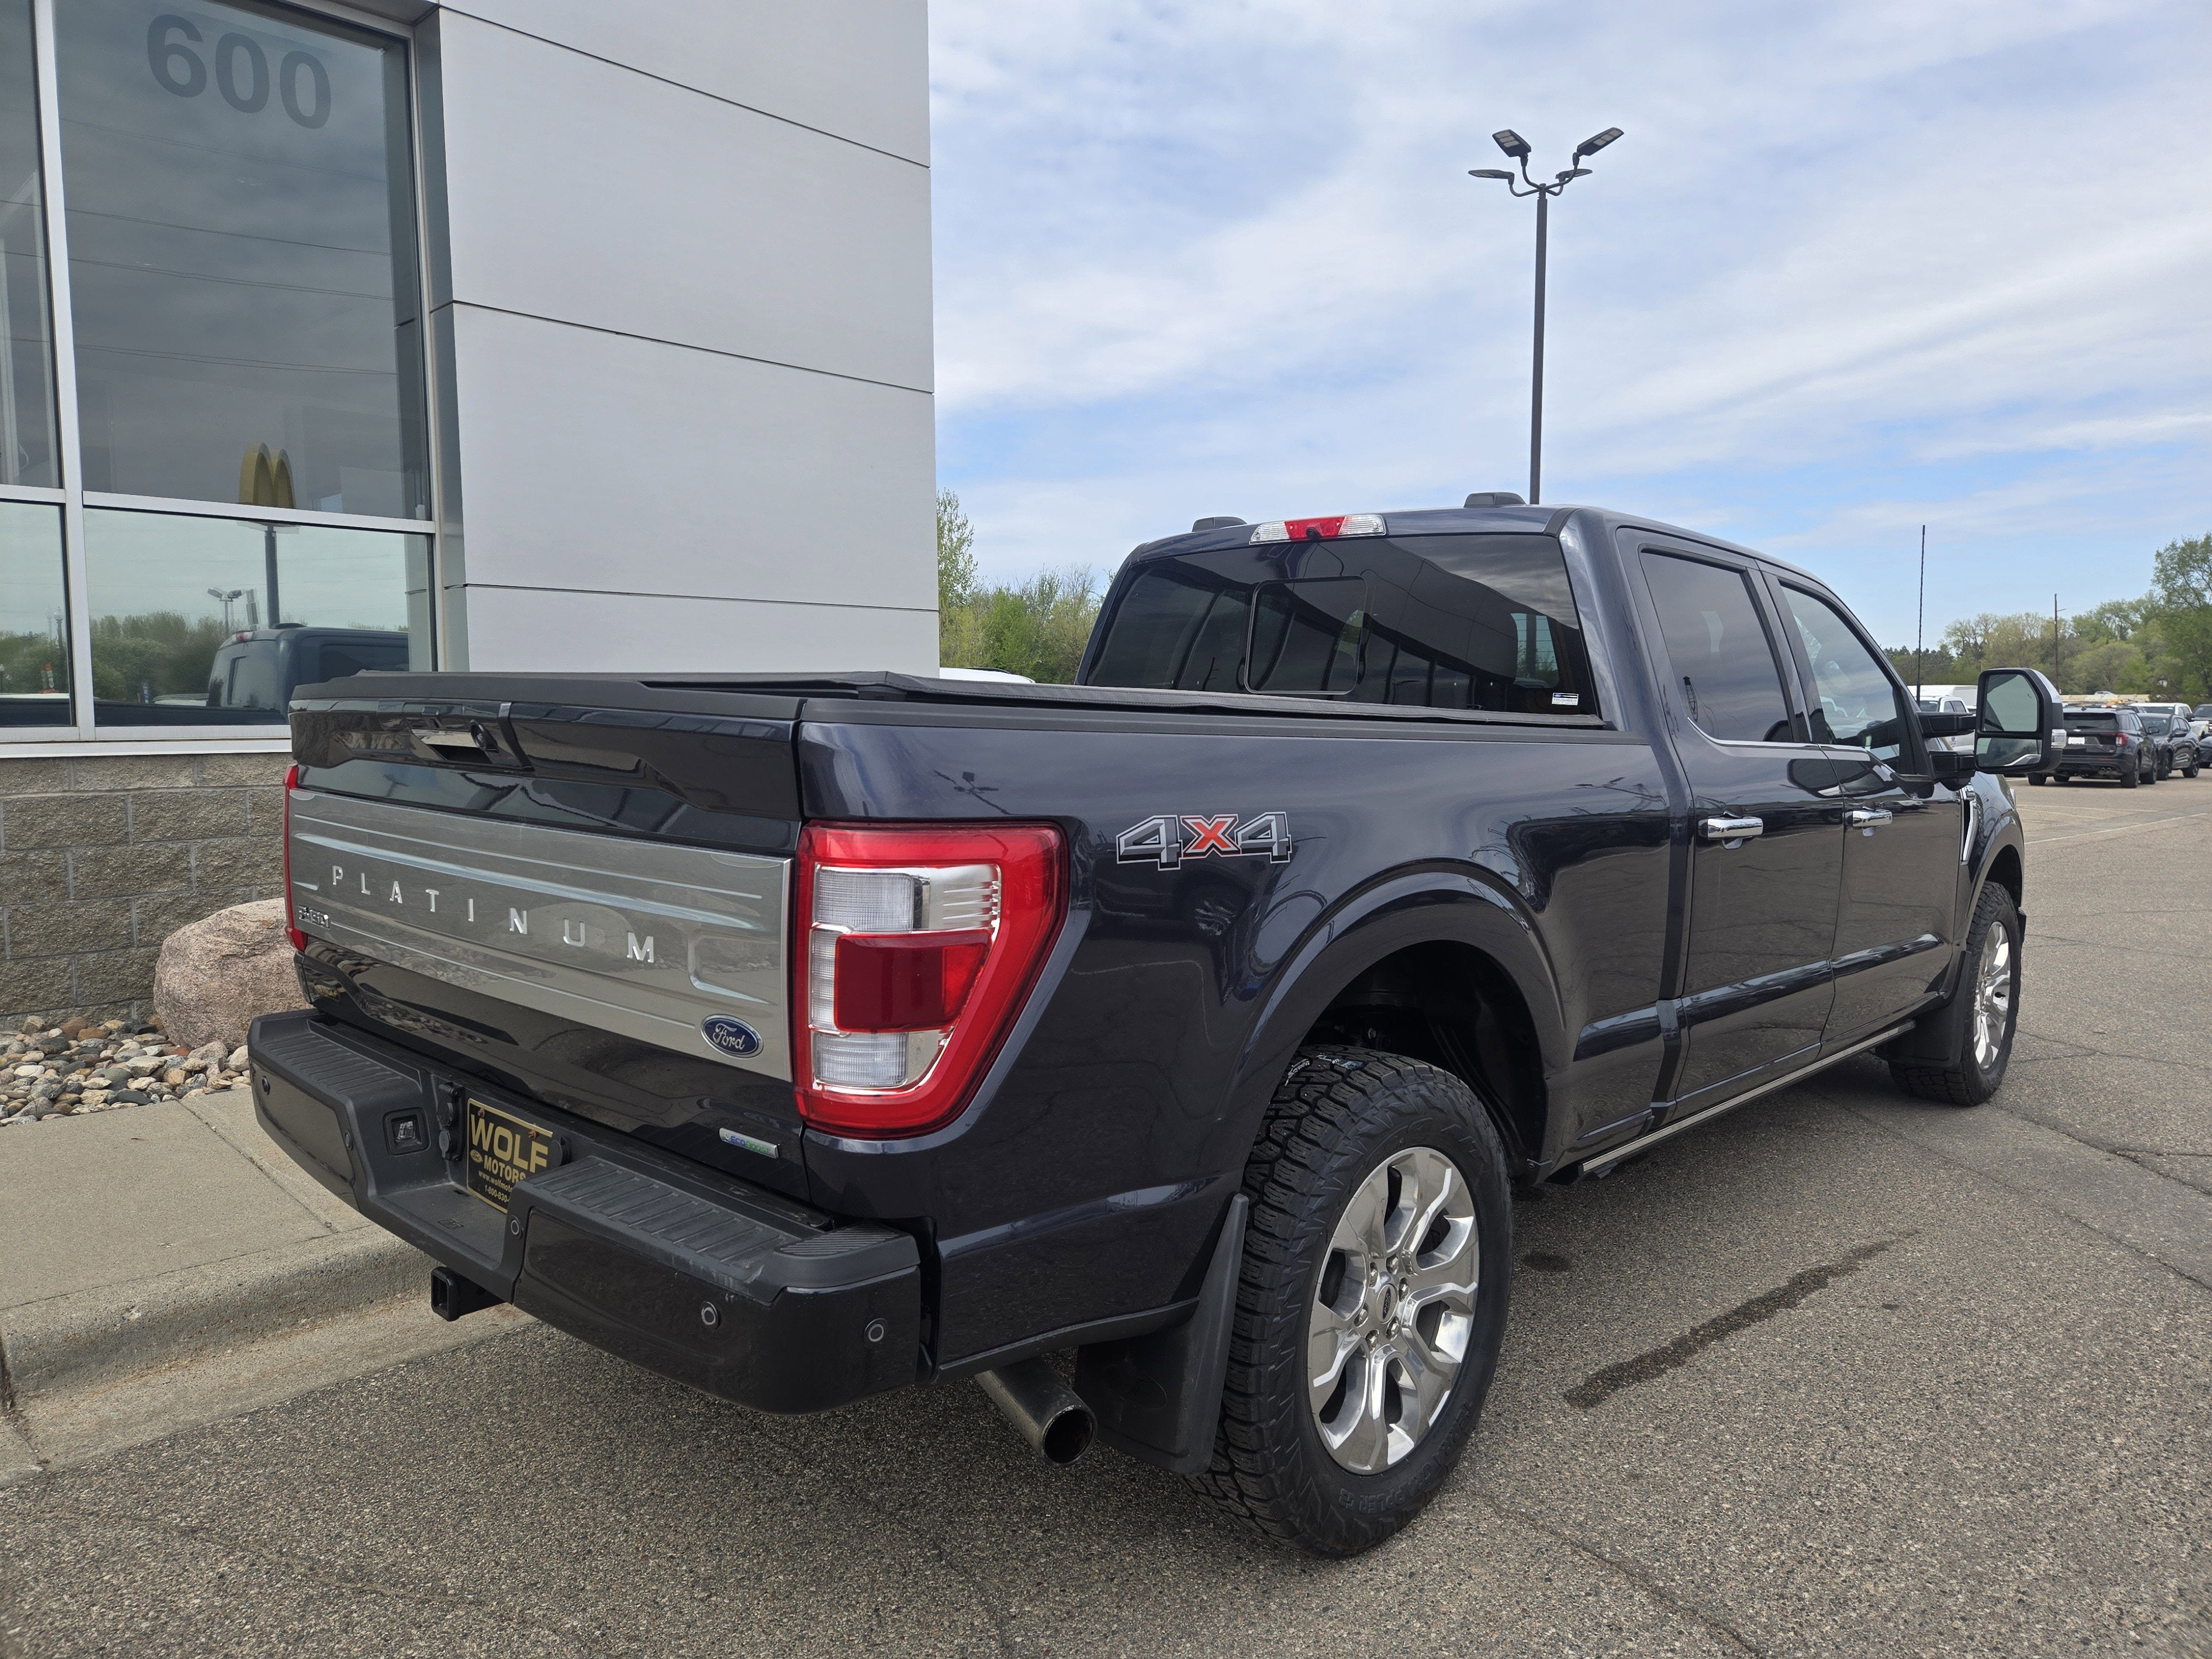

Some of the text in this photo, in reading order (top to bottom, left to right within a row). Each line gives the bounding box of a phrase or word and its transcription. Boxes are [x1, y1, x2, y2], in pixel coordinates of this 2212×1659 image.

[147, 14, 332, 129] 600
[333, 865, 655, 963] PLATINUM
[712, 1022, 745, 1050] Ford
[471, 1114, 548, 1173] WOLF
